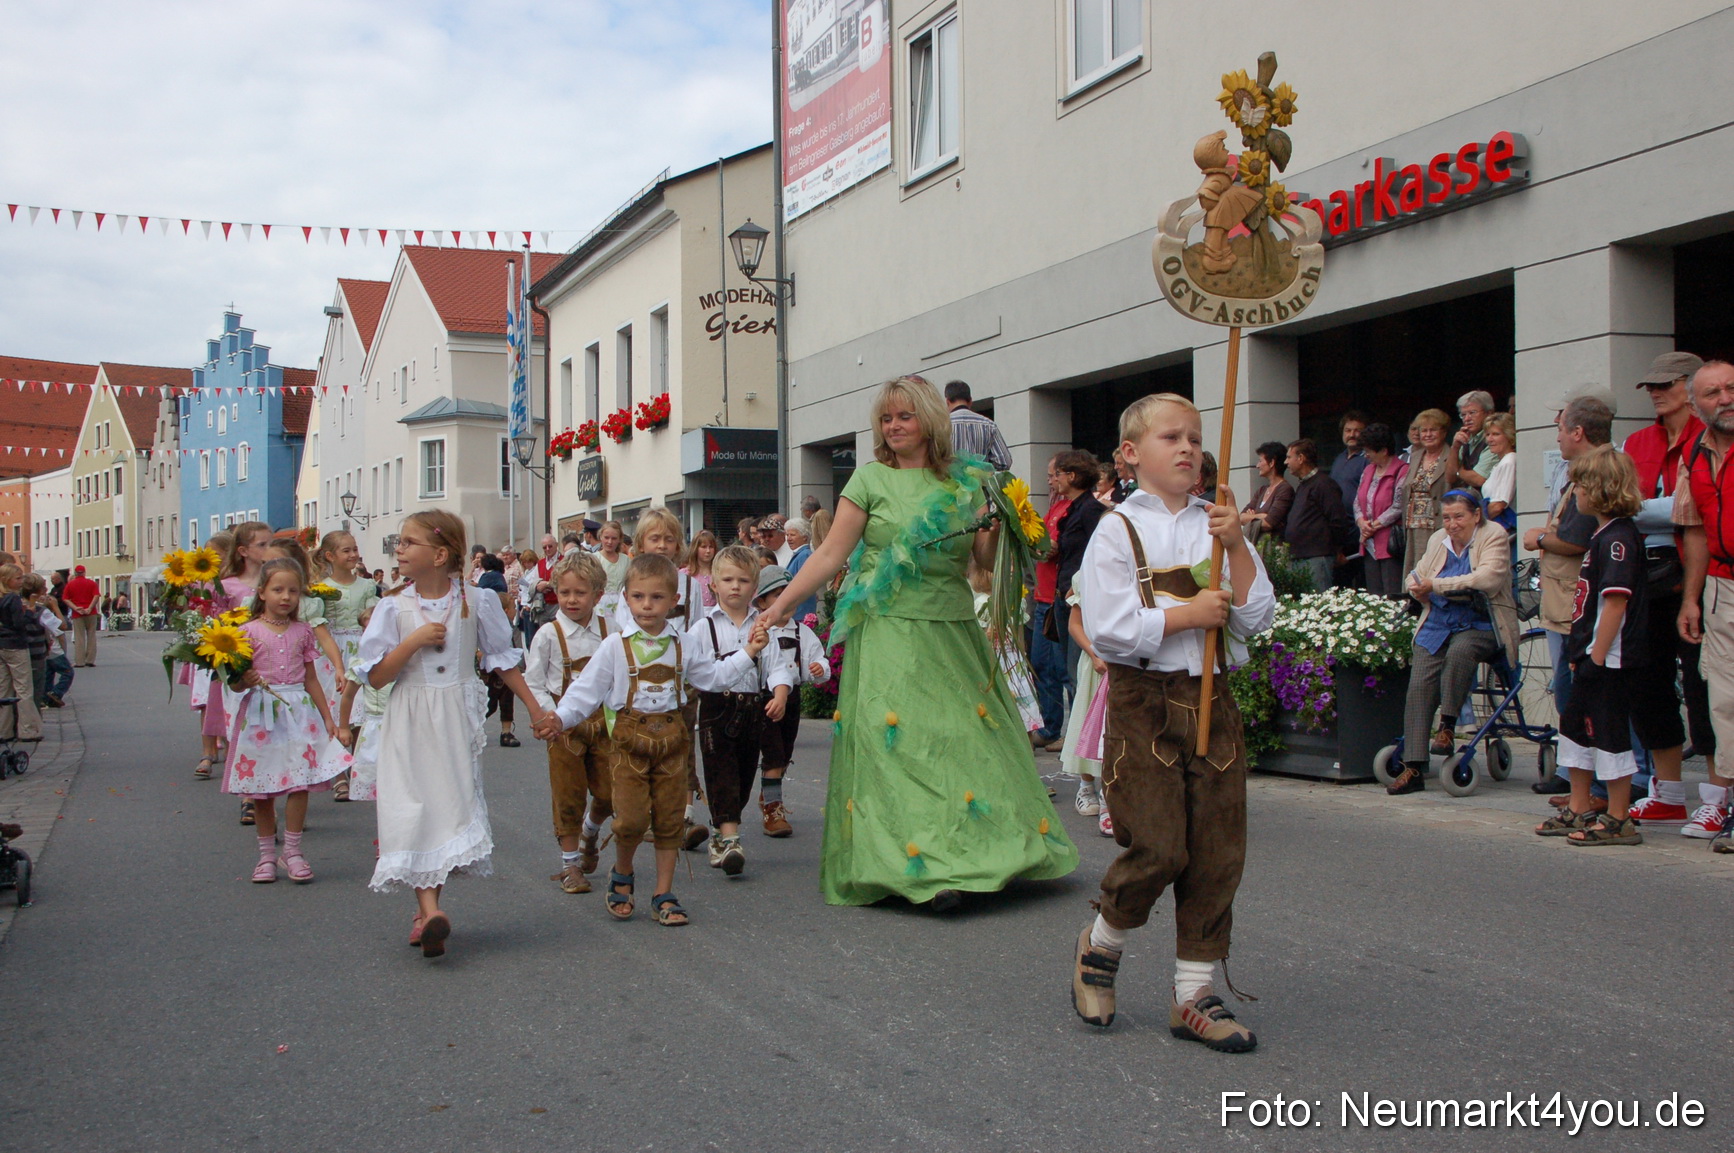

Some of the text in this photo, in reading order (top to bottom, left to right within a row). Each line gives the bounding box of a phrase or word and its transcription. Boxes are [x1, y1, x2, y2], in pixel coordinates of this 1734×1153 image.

[861, 15, 873, 49] B
[788, 116, 812, 138] Frage 4:
[788, 144, 802, 158] Was
[801, 132, 819, 151] wurde
[819, 125, 828, 139] bis
[828, 120, 837, 133] ins
[788, 161, 799, 176] am
[854, 102, 886, 134] angebaut?
[1280, 130, 1515, 237] arkasse
[699, 287, 777, 310] MODEHA
[1162, 255, 1322, 325] OGV-Aschbuch
[711, 450, 735, 460] Mode
[737, 450, 747, 460] für
[1611, 541, 1626, 561] 9
